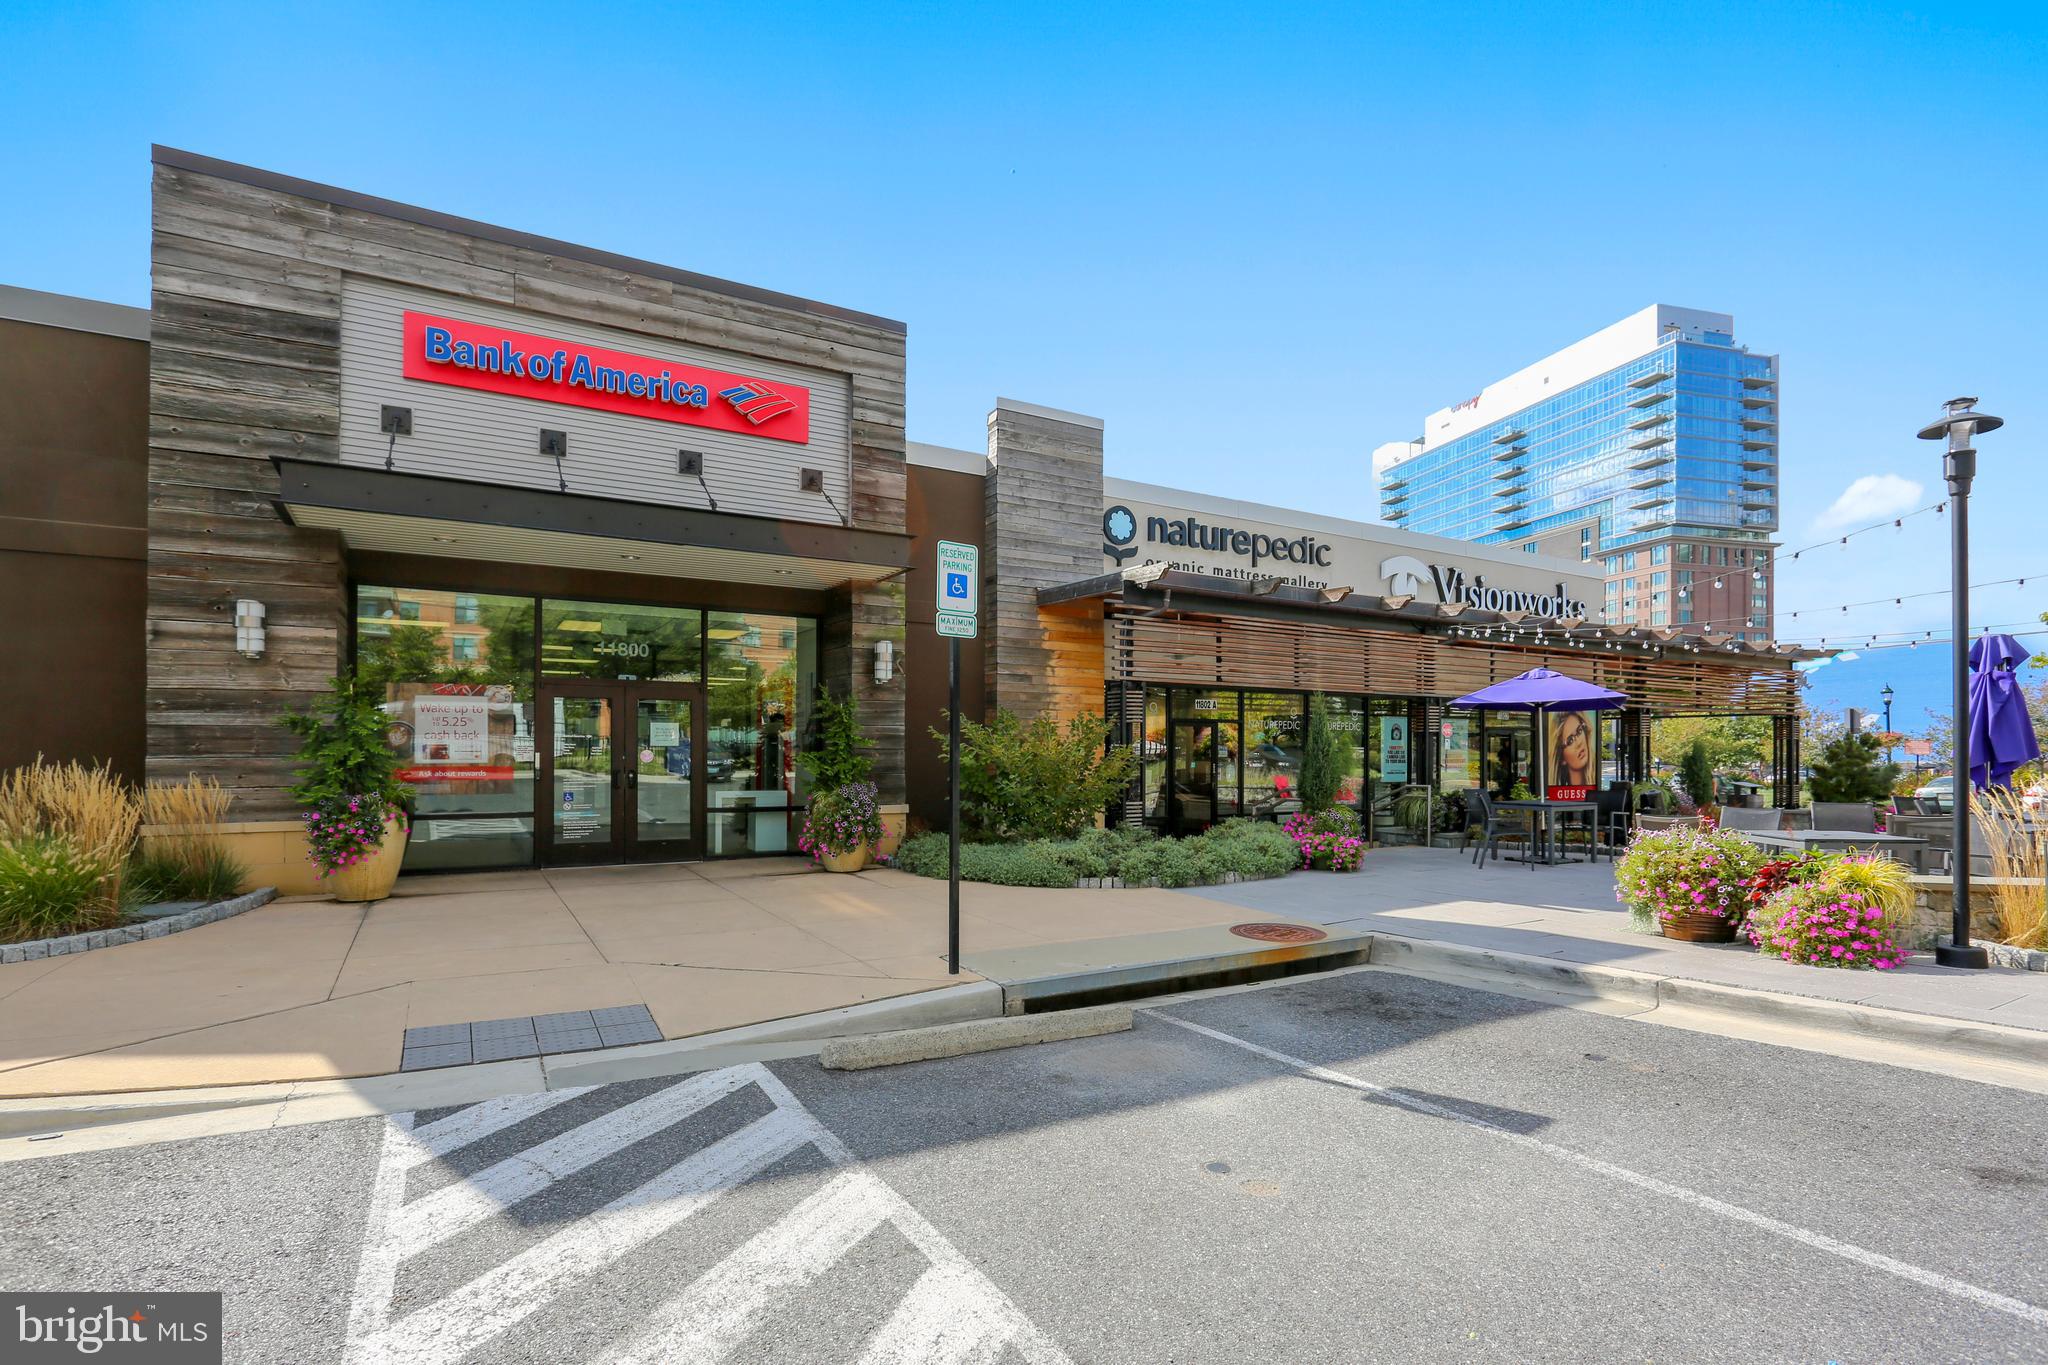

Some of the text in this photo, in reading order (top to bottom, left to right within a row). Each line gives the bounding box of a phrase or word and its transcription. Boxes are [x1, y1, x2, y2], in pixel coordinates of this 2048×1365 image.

[425, 325, 709, 408] Bank of America
[1147, 513, 1332, 568] naturepedic
[940, 548, 975, 561] RESERVED
[943, 561, 972, 572] PARKING
[1145, 558, 1205, 574] oranic
[1430, 564, 1587, 620] Visionworks
[940, 617, 974, 627] MAXIMUM
[598, 641, 650, 657] 11800
[420, 703, 484, 716] Wake up to
[1213, 701, 1217, 709] A
[1249, 720, 1300, 730] NATUREPEDIC
[424, 729, 480, 740] cash back
[1557, 789, 1587, 799] GUESS
